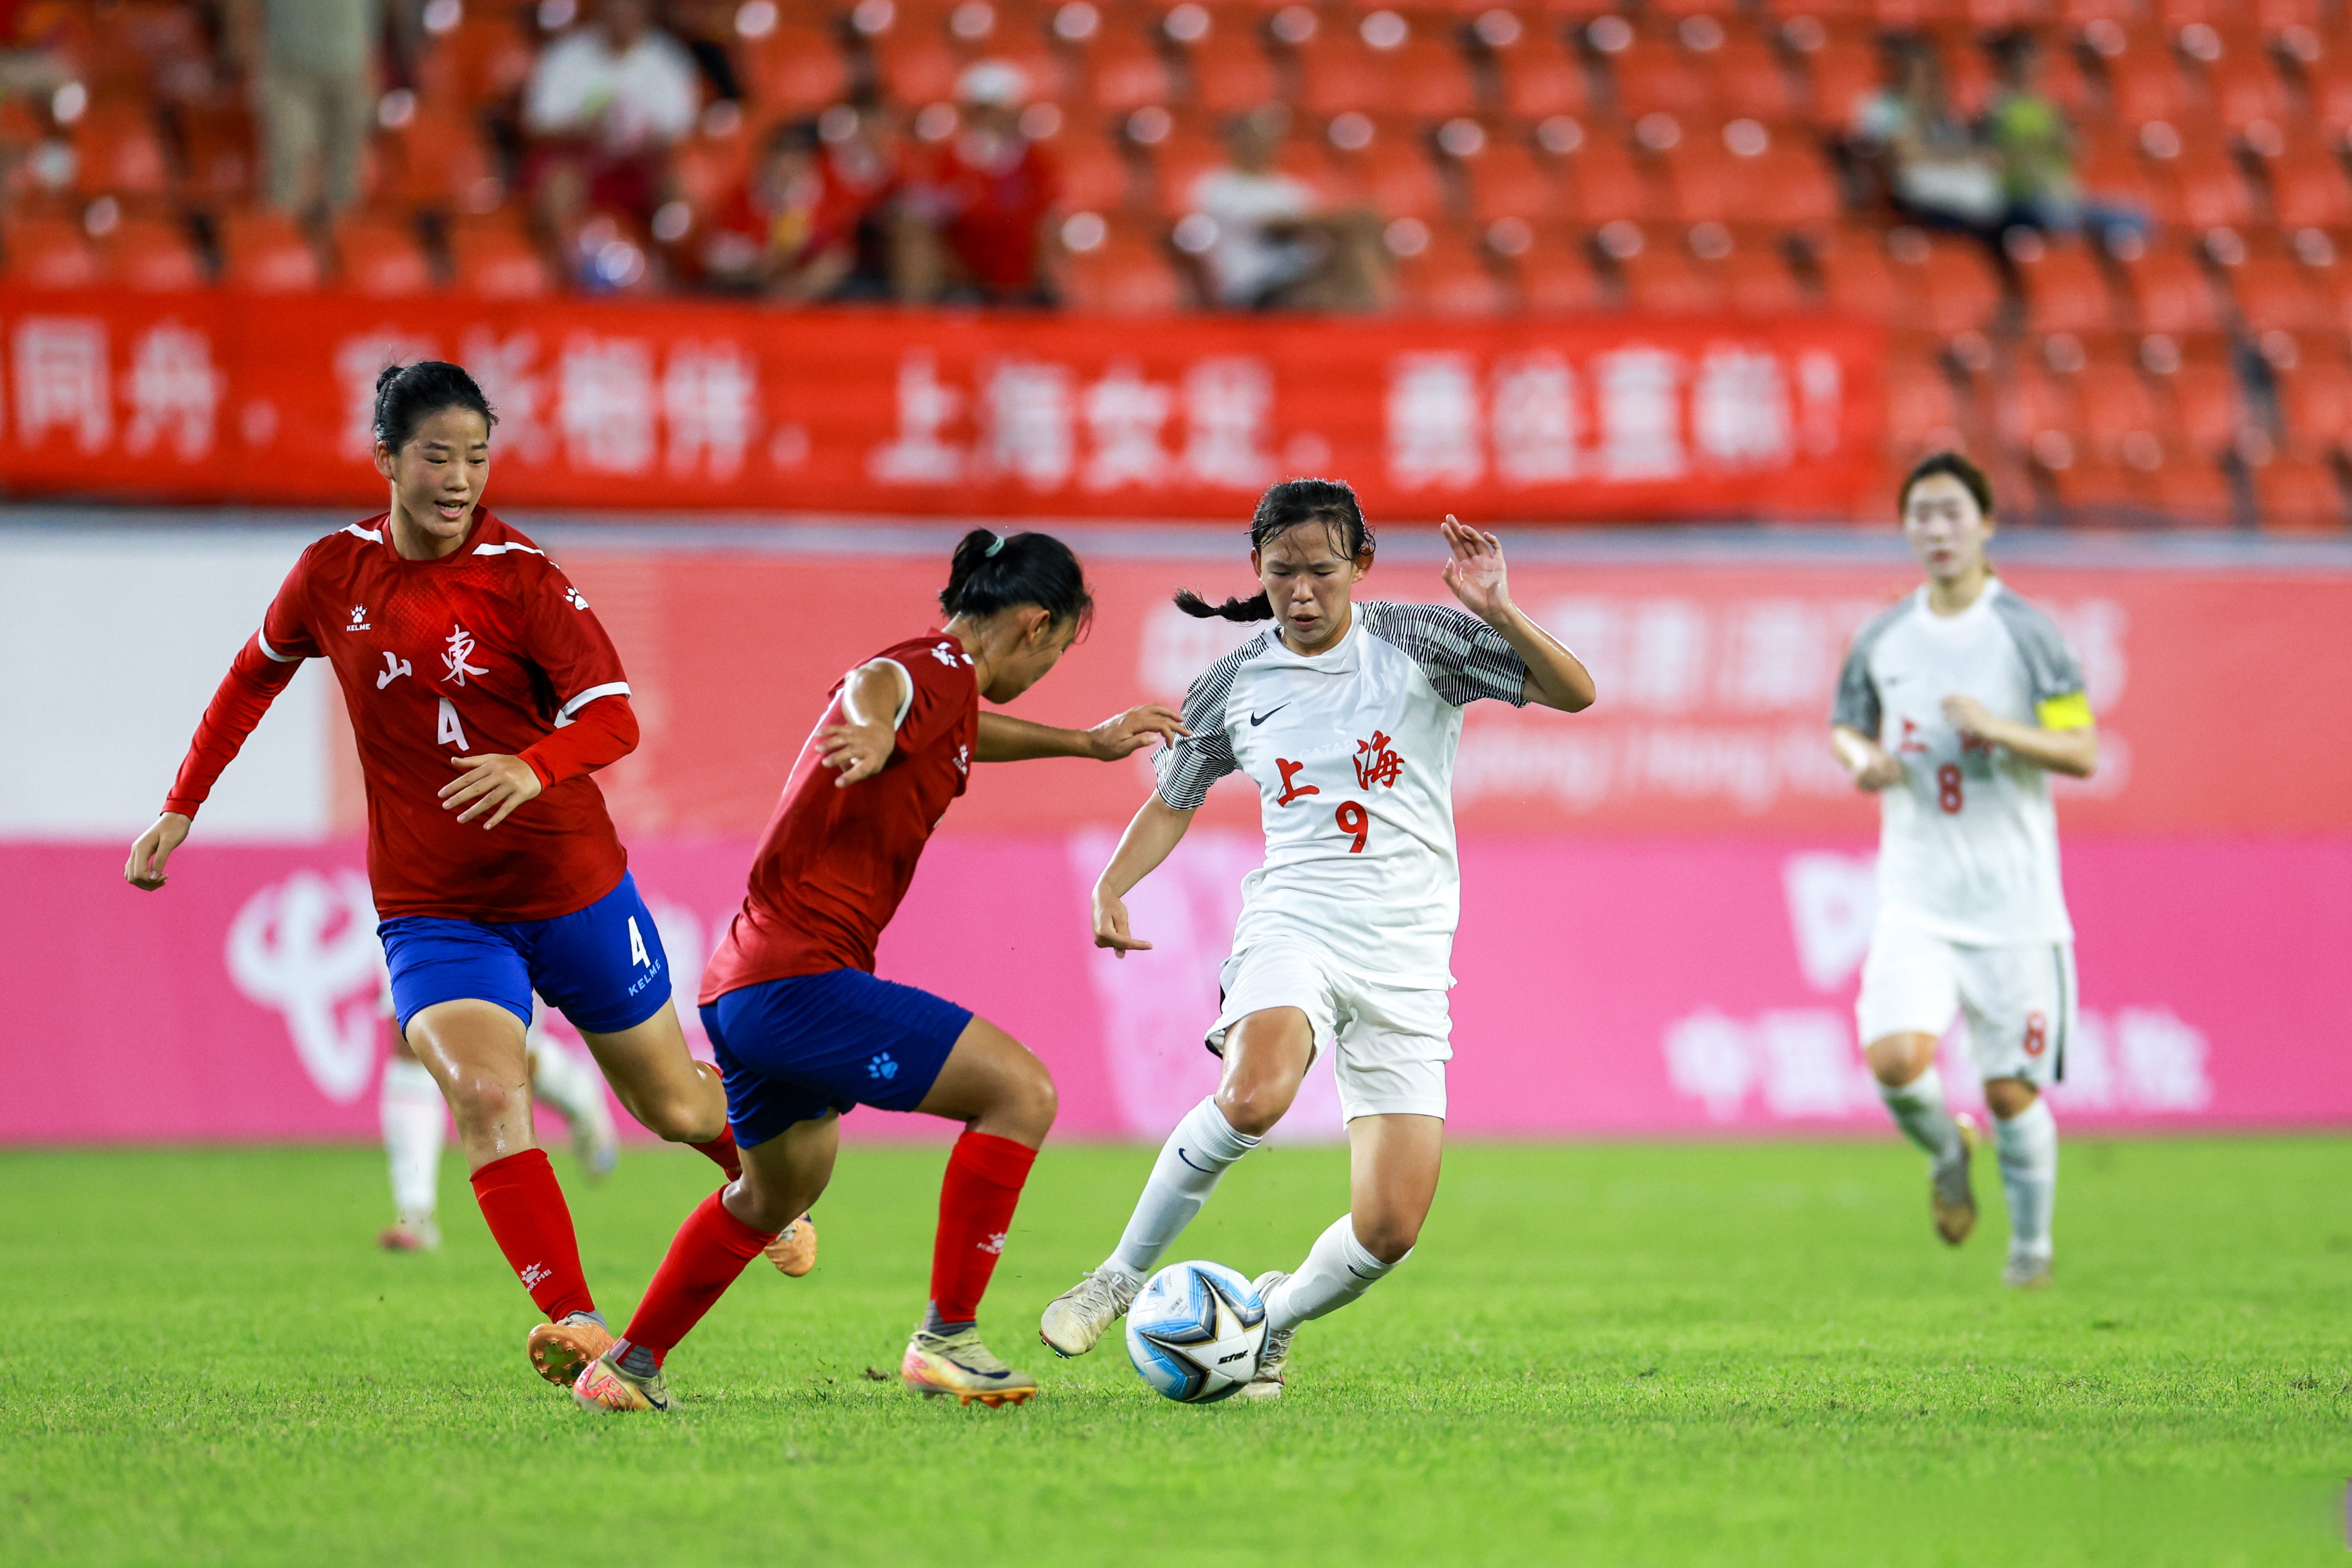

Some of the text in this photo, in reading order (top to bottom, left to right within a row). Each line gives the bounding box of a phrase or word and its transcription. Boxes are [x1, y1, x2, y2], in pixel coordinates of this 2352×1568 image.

[346, 623, 371, 632] KELME
[438, 697, 470, 751] 4
[1276, 730, 1405, 808] 上海
[1937, 762, 1963, 816] 8
[1335, 800, 1369, 853] 9
[628, 915, 651, 969] 4
[628, 958, 661, 997] KELME
[2023, 1010, 2046, 1057] 8
